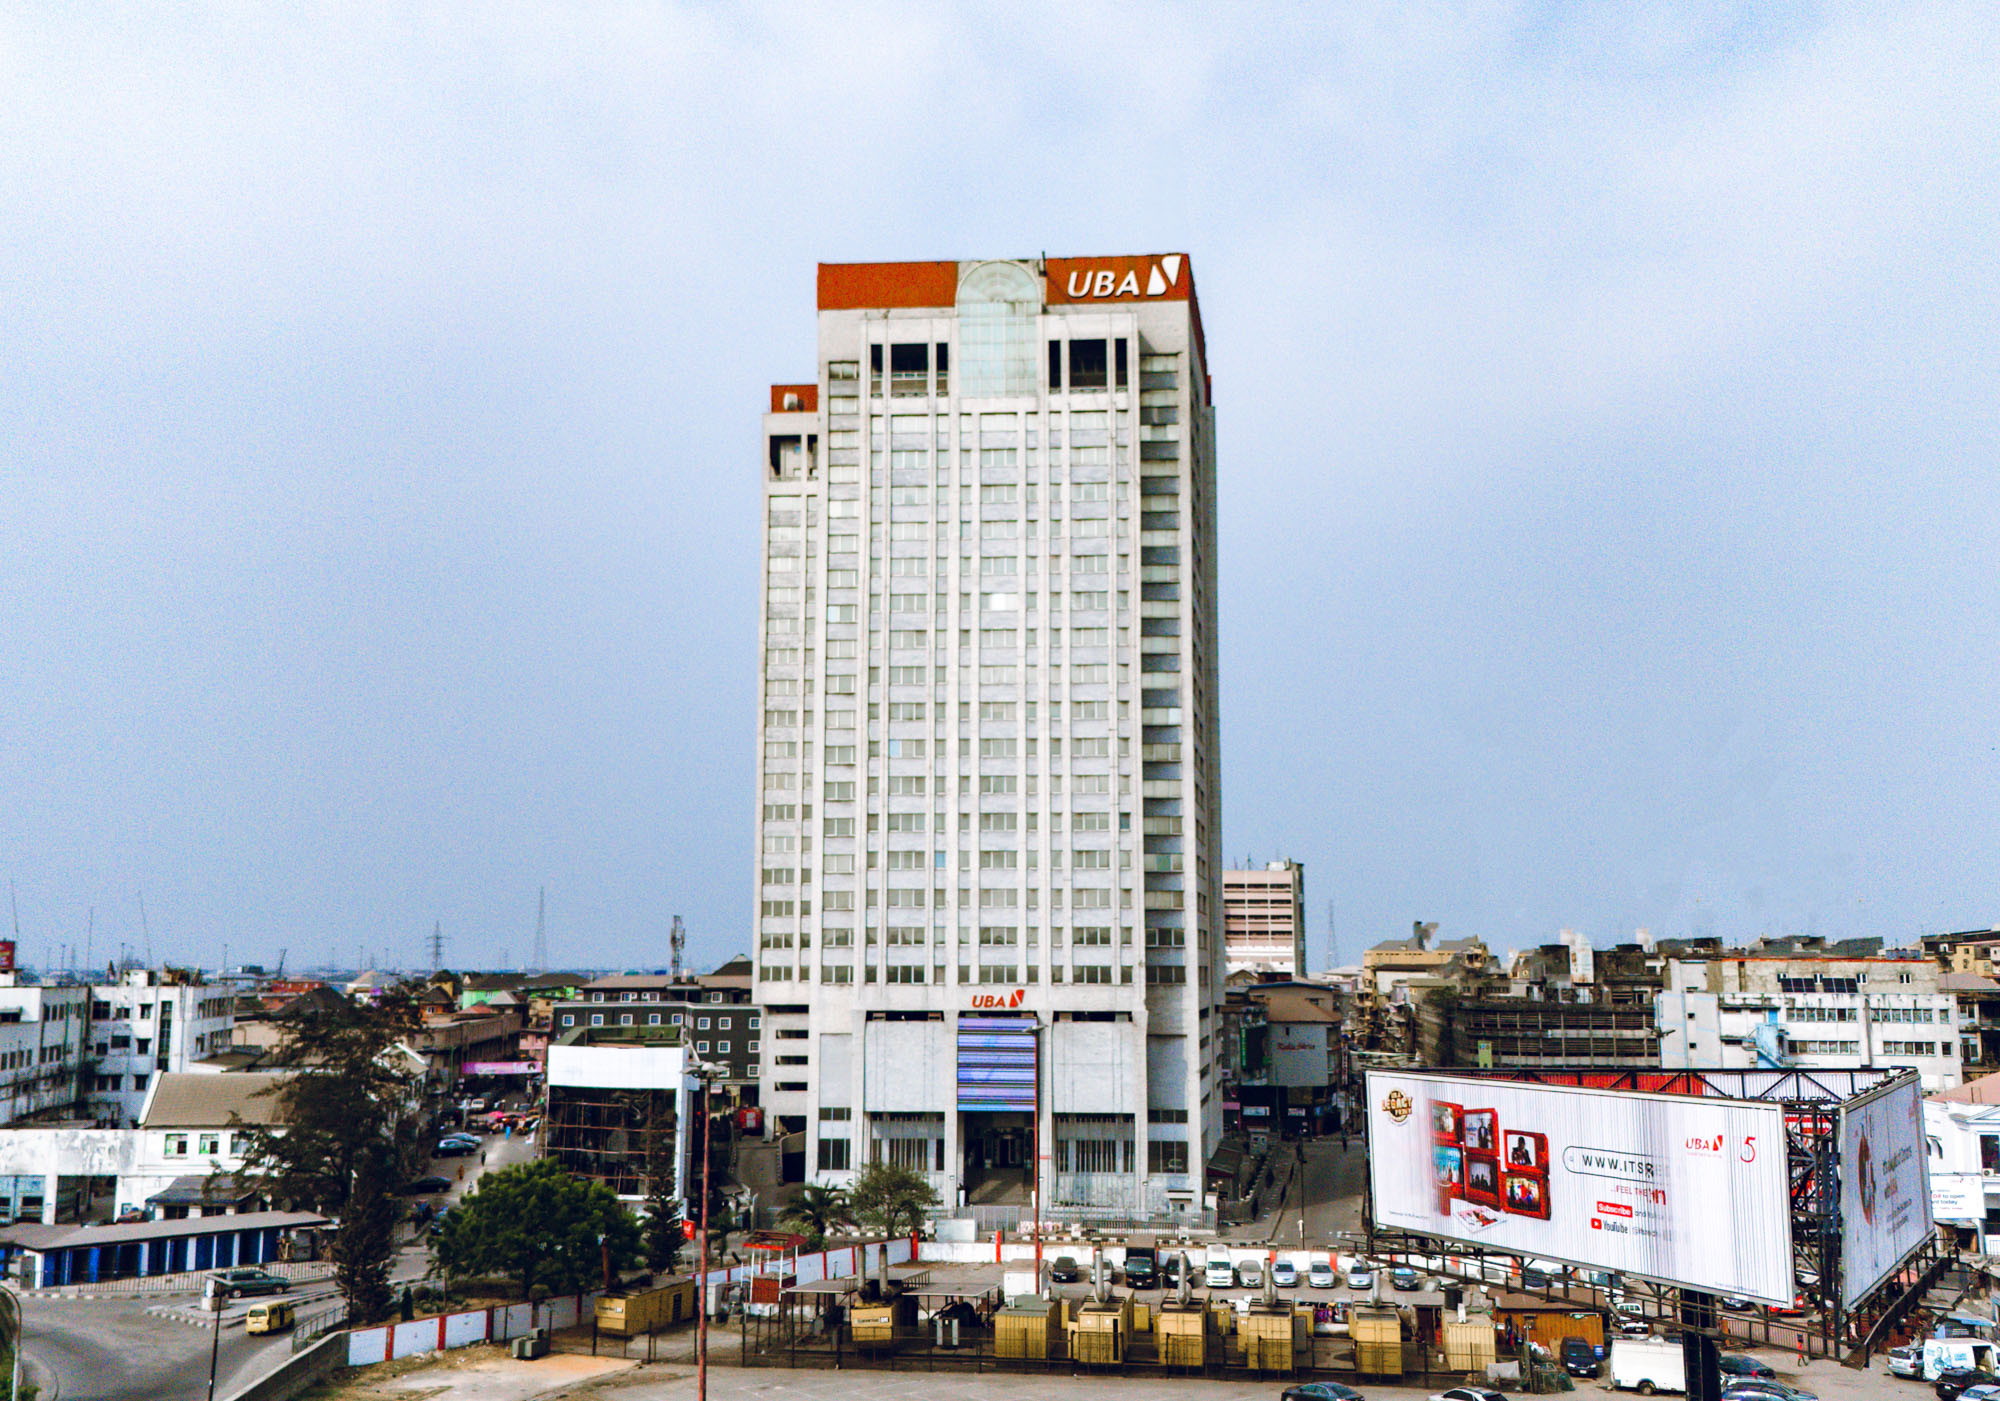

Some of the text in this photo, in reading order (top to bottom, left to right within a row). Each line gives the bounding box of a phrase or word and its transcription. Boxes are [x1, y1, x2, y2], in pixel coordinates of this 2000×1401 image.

[1067, 270, 1140, 298] UBA
[971, 995, 1006, 1008] UBA
[1381, 1097, 1413, 1111] LEGACY
[1685, 1137, 1710, 1151] UBA
[1598, 1203, 1632, 1216] Subscribe
[1603, 1220, 1629, 1234] YouTube
